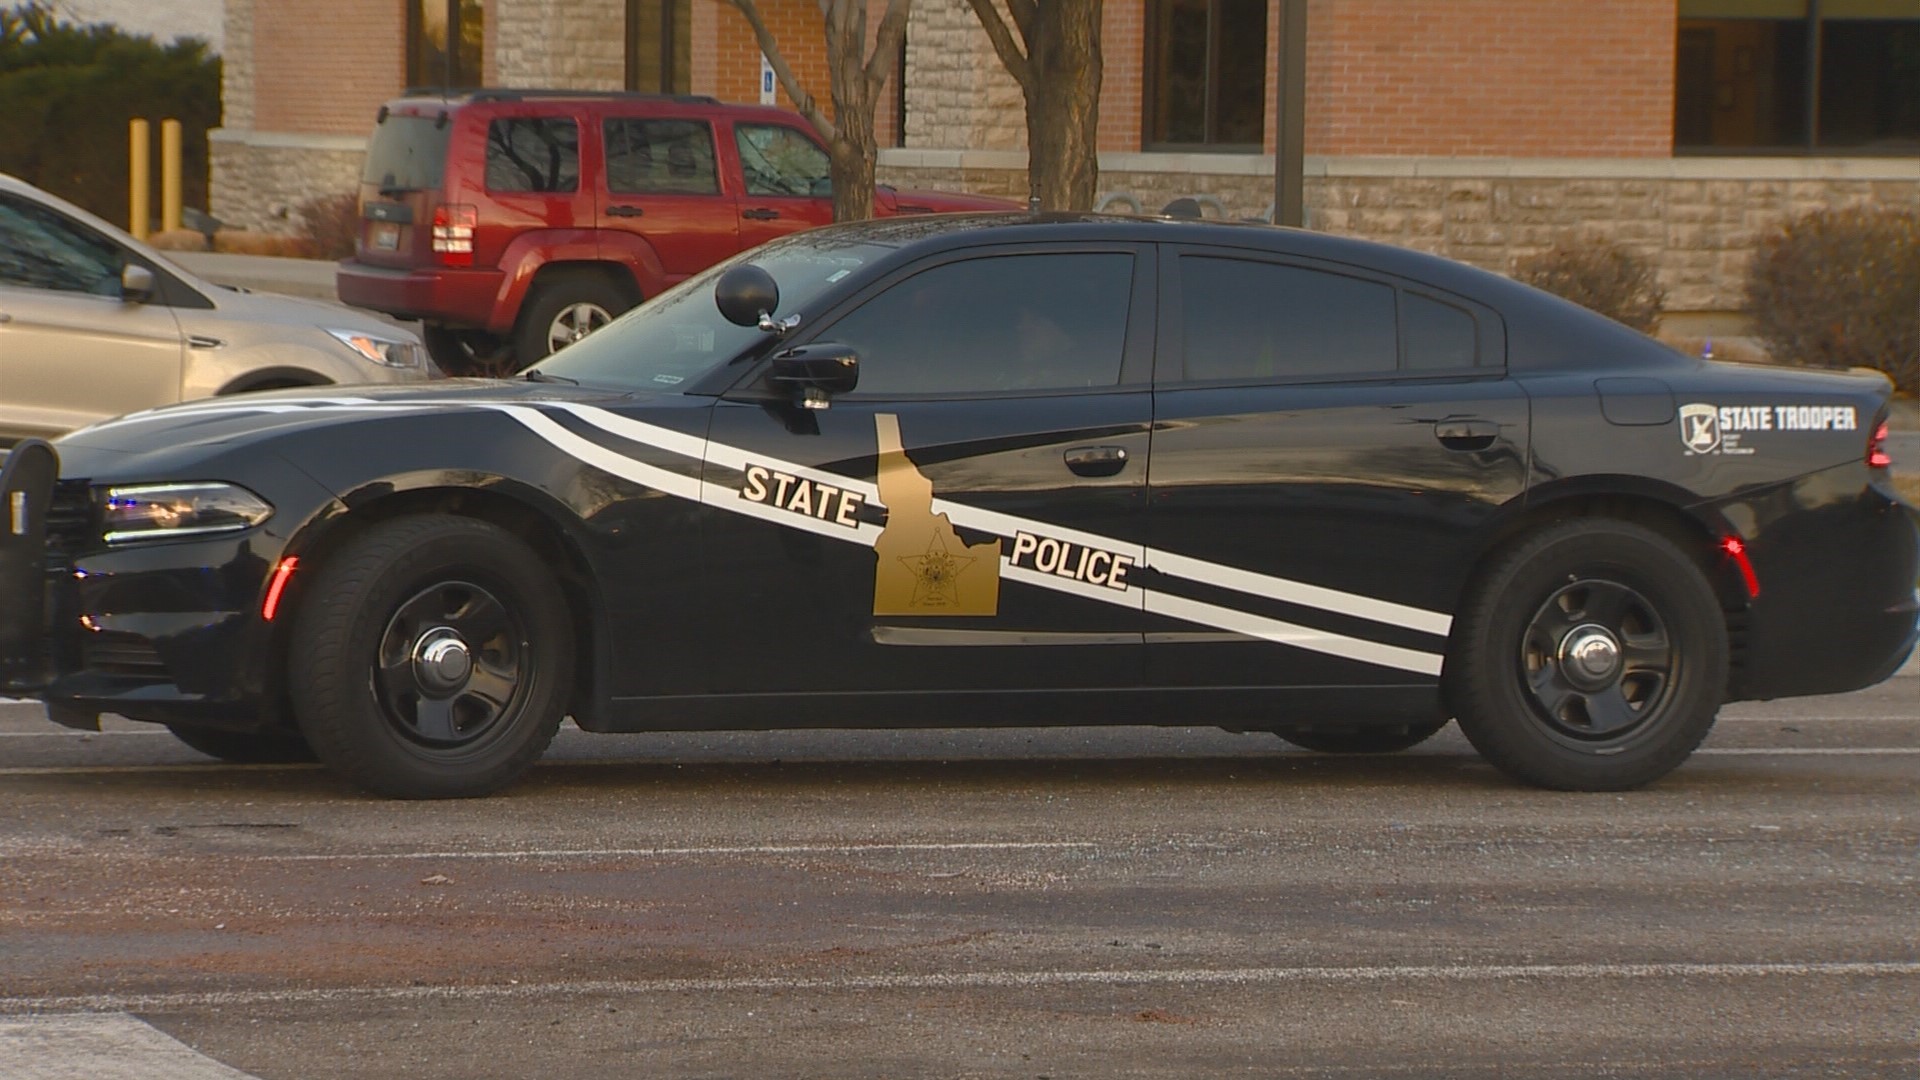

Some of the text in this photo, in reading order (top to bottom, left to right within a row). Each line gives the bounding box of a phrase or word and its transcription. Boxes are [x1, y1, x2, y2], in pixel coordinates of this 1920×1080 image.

[1720, 406, 1856, 430] STATE TROOPER
[743, 466, 1134, 591] STATE POLICE
